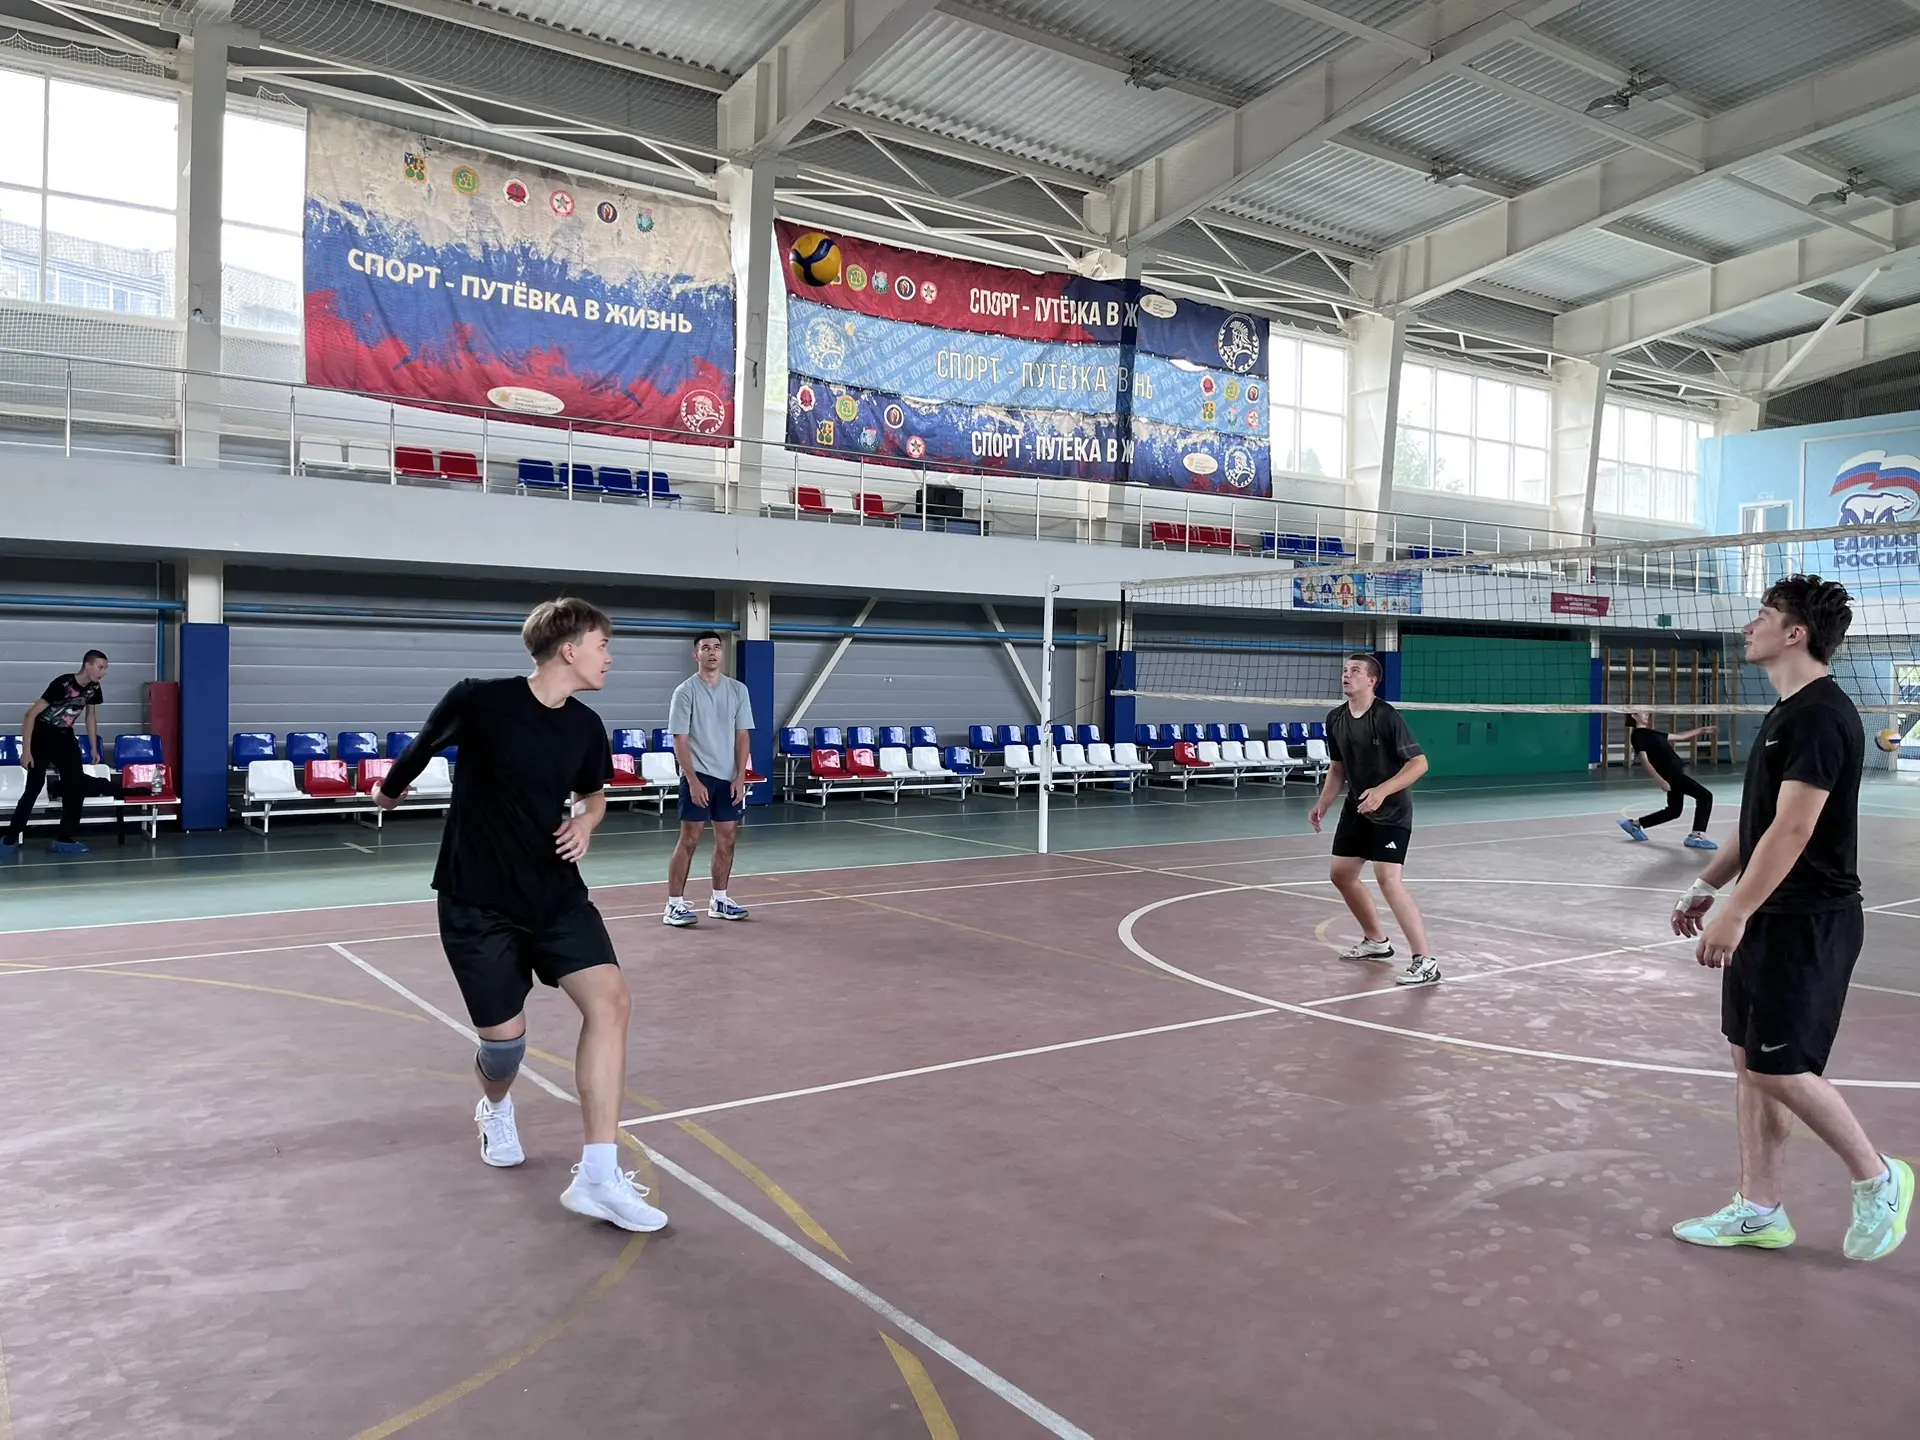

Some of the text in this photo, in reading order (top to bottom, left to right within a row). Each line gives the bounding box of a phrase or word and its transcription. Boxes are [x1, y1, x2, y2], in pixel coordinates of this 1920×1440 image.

[348, 249, 441, 289] СПОРТ
[461, 274, 578, 318] ПУТЁВКА
[584, 299, 600, 321] В
[604, 302, 692, 334] ЖИЗНЬ
[969, 287, 1020, 319] СПОРТ
[1106, 302, 1119, 326] В
[937, 350, 1000, 384] СПОРТ
[1118, 366, 1129, 392] В
[971, 431, 1022, 458] СПОРТ
[1106, 438, 1118, 463] В
[1834, 533, 1917, 551] ЕДИНАЯ
[1834, 551, 1917, 568] РОССИЯ
